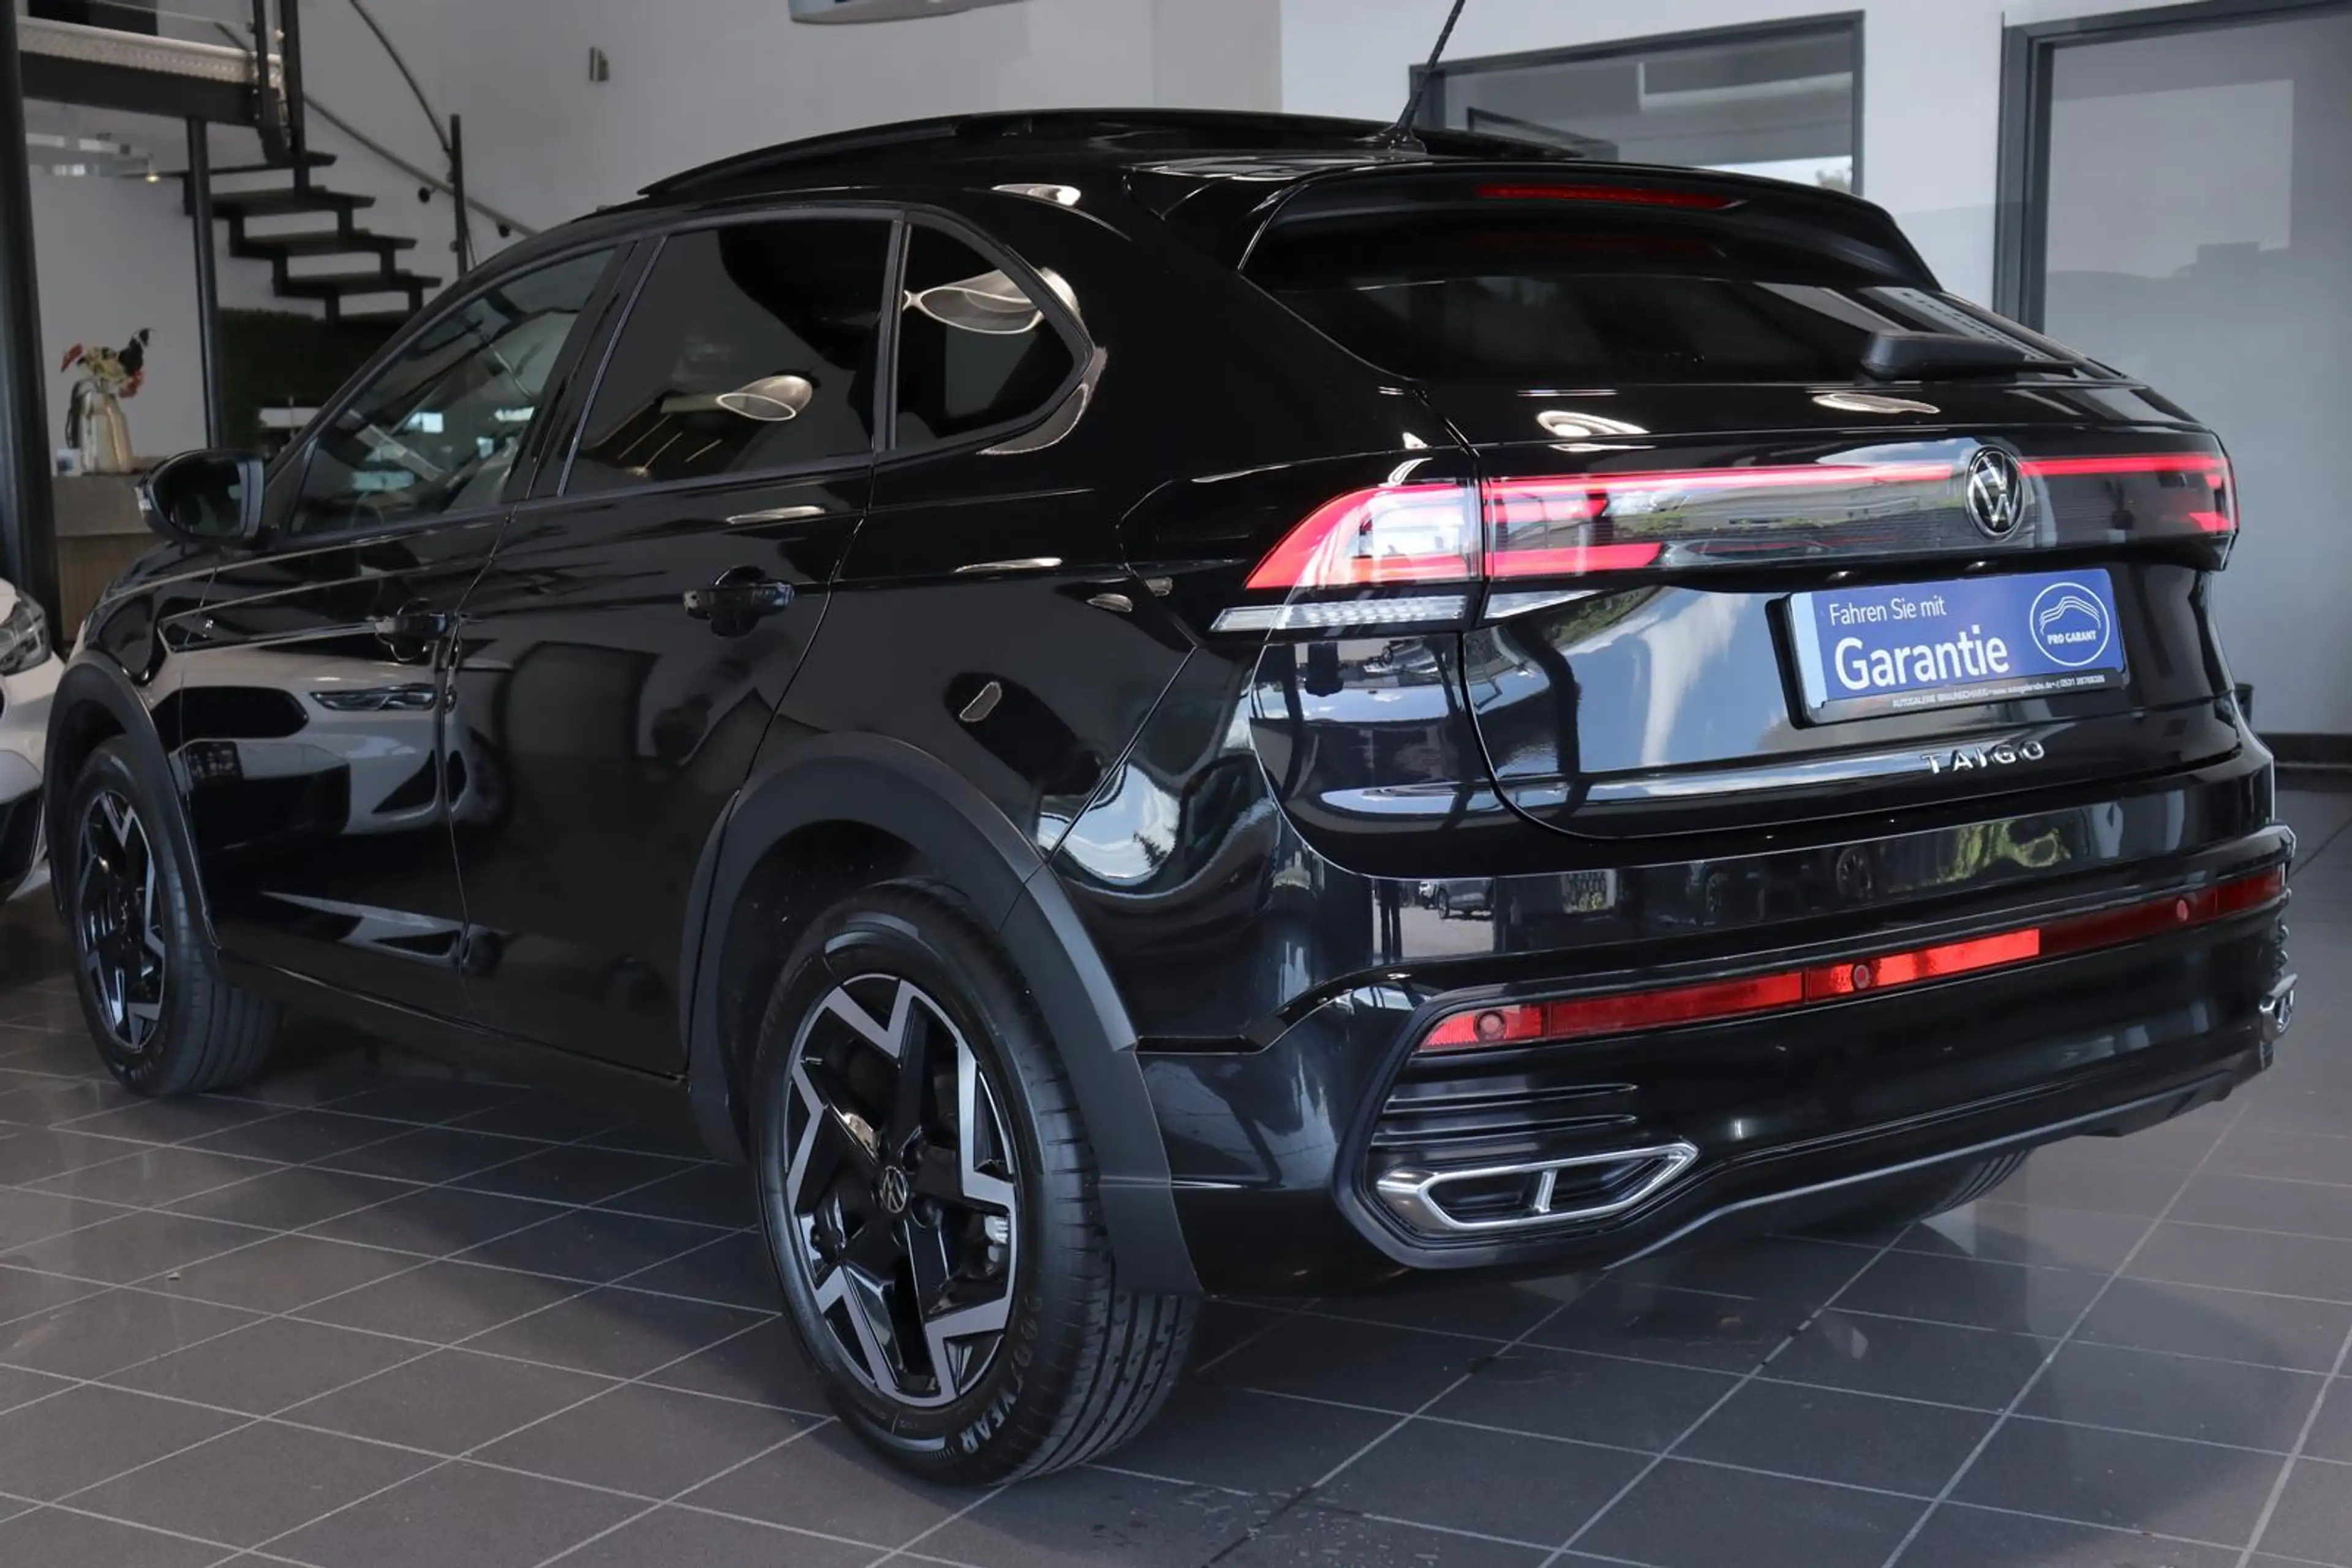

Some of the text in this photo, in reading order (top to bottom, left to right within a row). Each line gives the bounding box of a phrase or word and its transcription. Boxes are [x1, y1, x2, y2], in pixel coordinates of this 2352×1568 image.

[1828, 594, 1948, 626] Fahren Sie mit
[2046, 633, 2064, 646] PRO
[1834, 624, 2010, 691] Garantie
[1920, 740, 2045, 775] TAIGO
